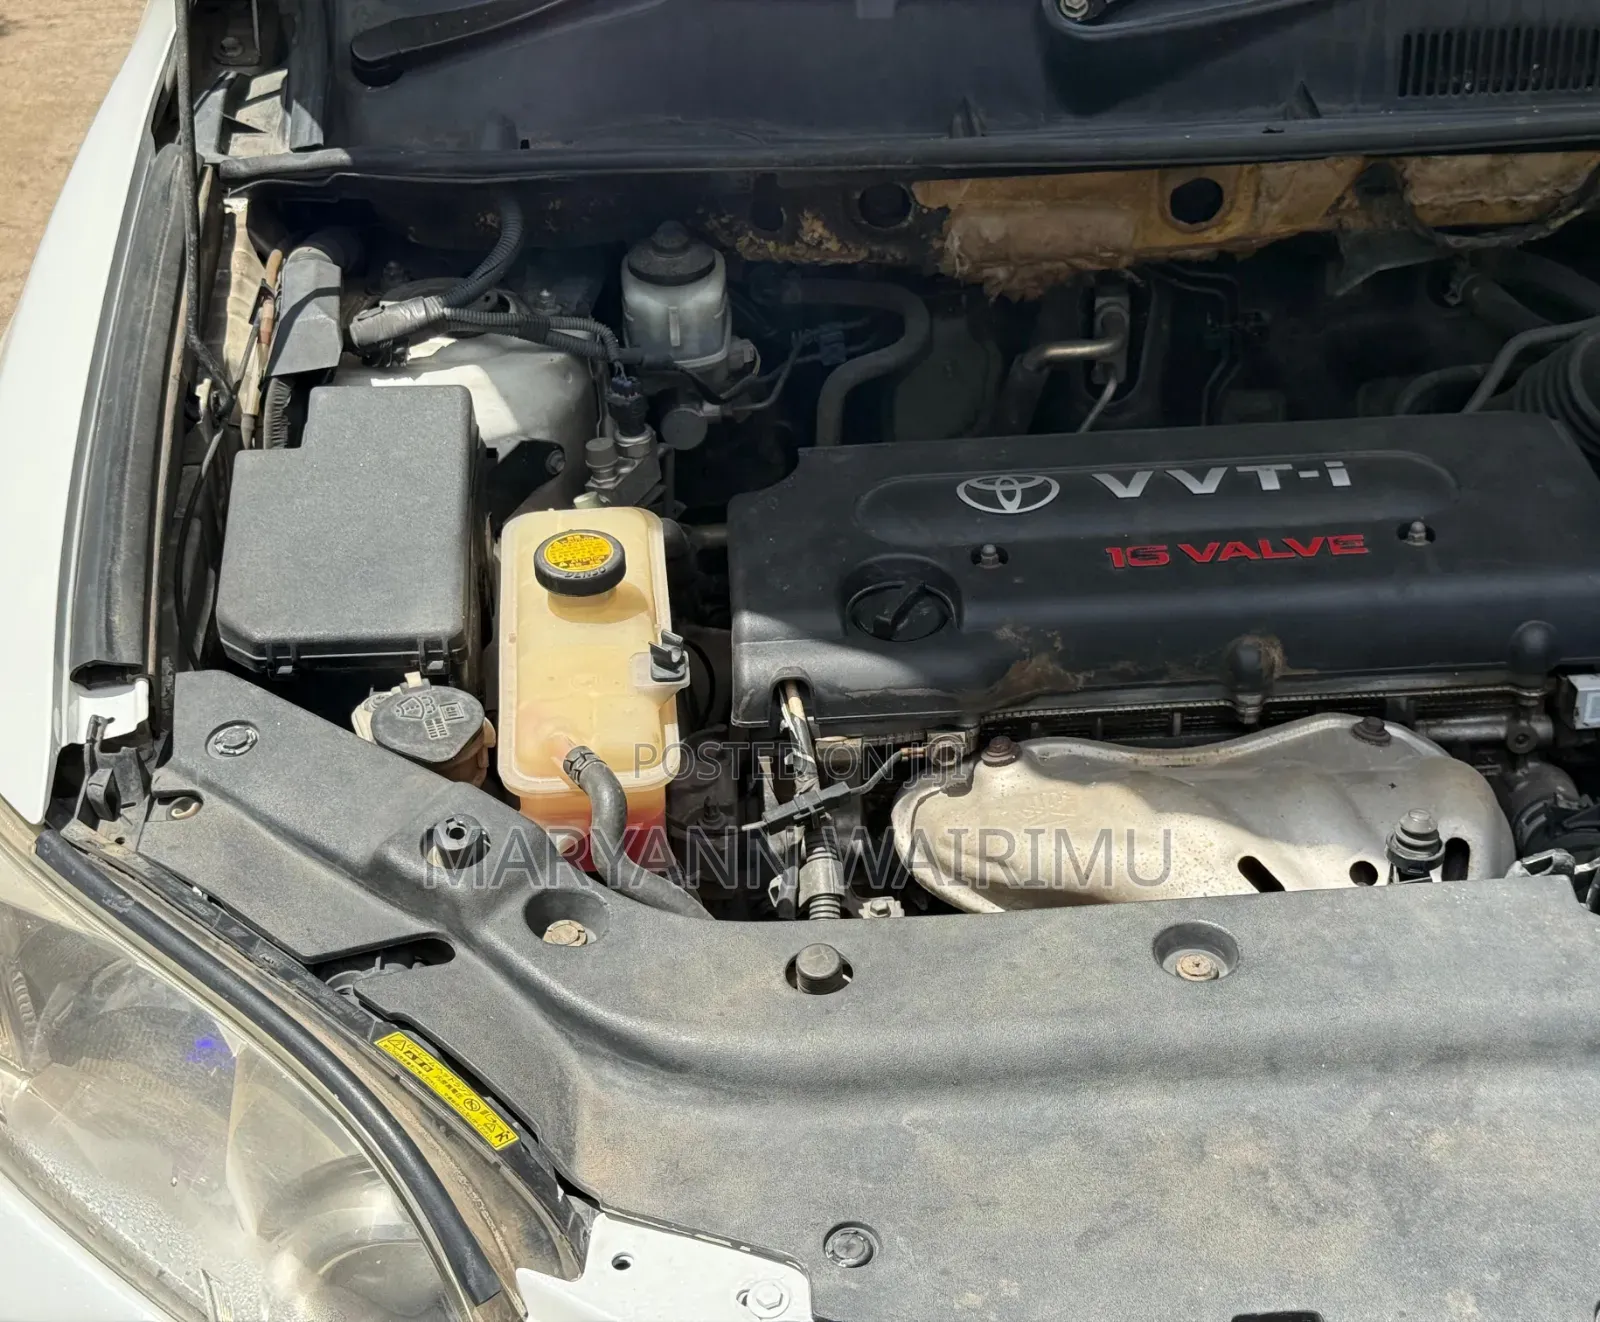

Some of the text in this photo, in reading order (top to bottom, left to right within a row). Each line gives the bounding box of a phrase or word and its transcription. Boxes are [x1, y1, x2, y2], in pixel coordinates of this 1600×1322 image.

[1091, 461, 1352, 499] VVT-i
[1105, 534, 1369, 569] 16 VALVE
